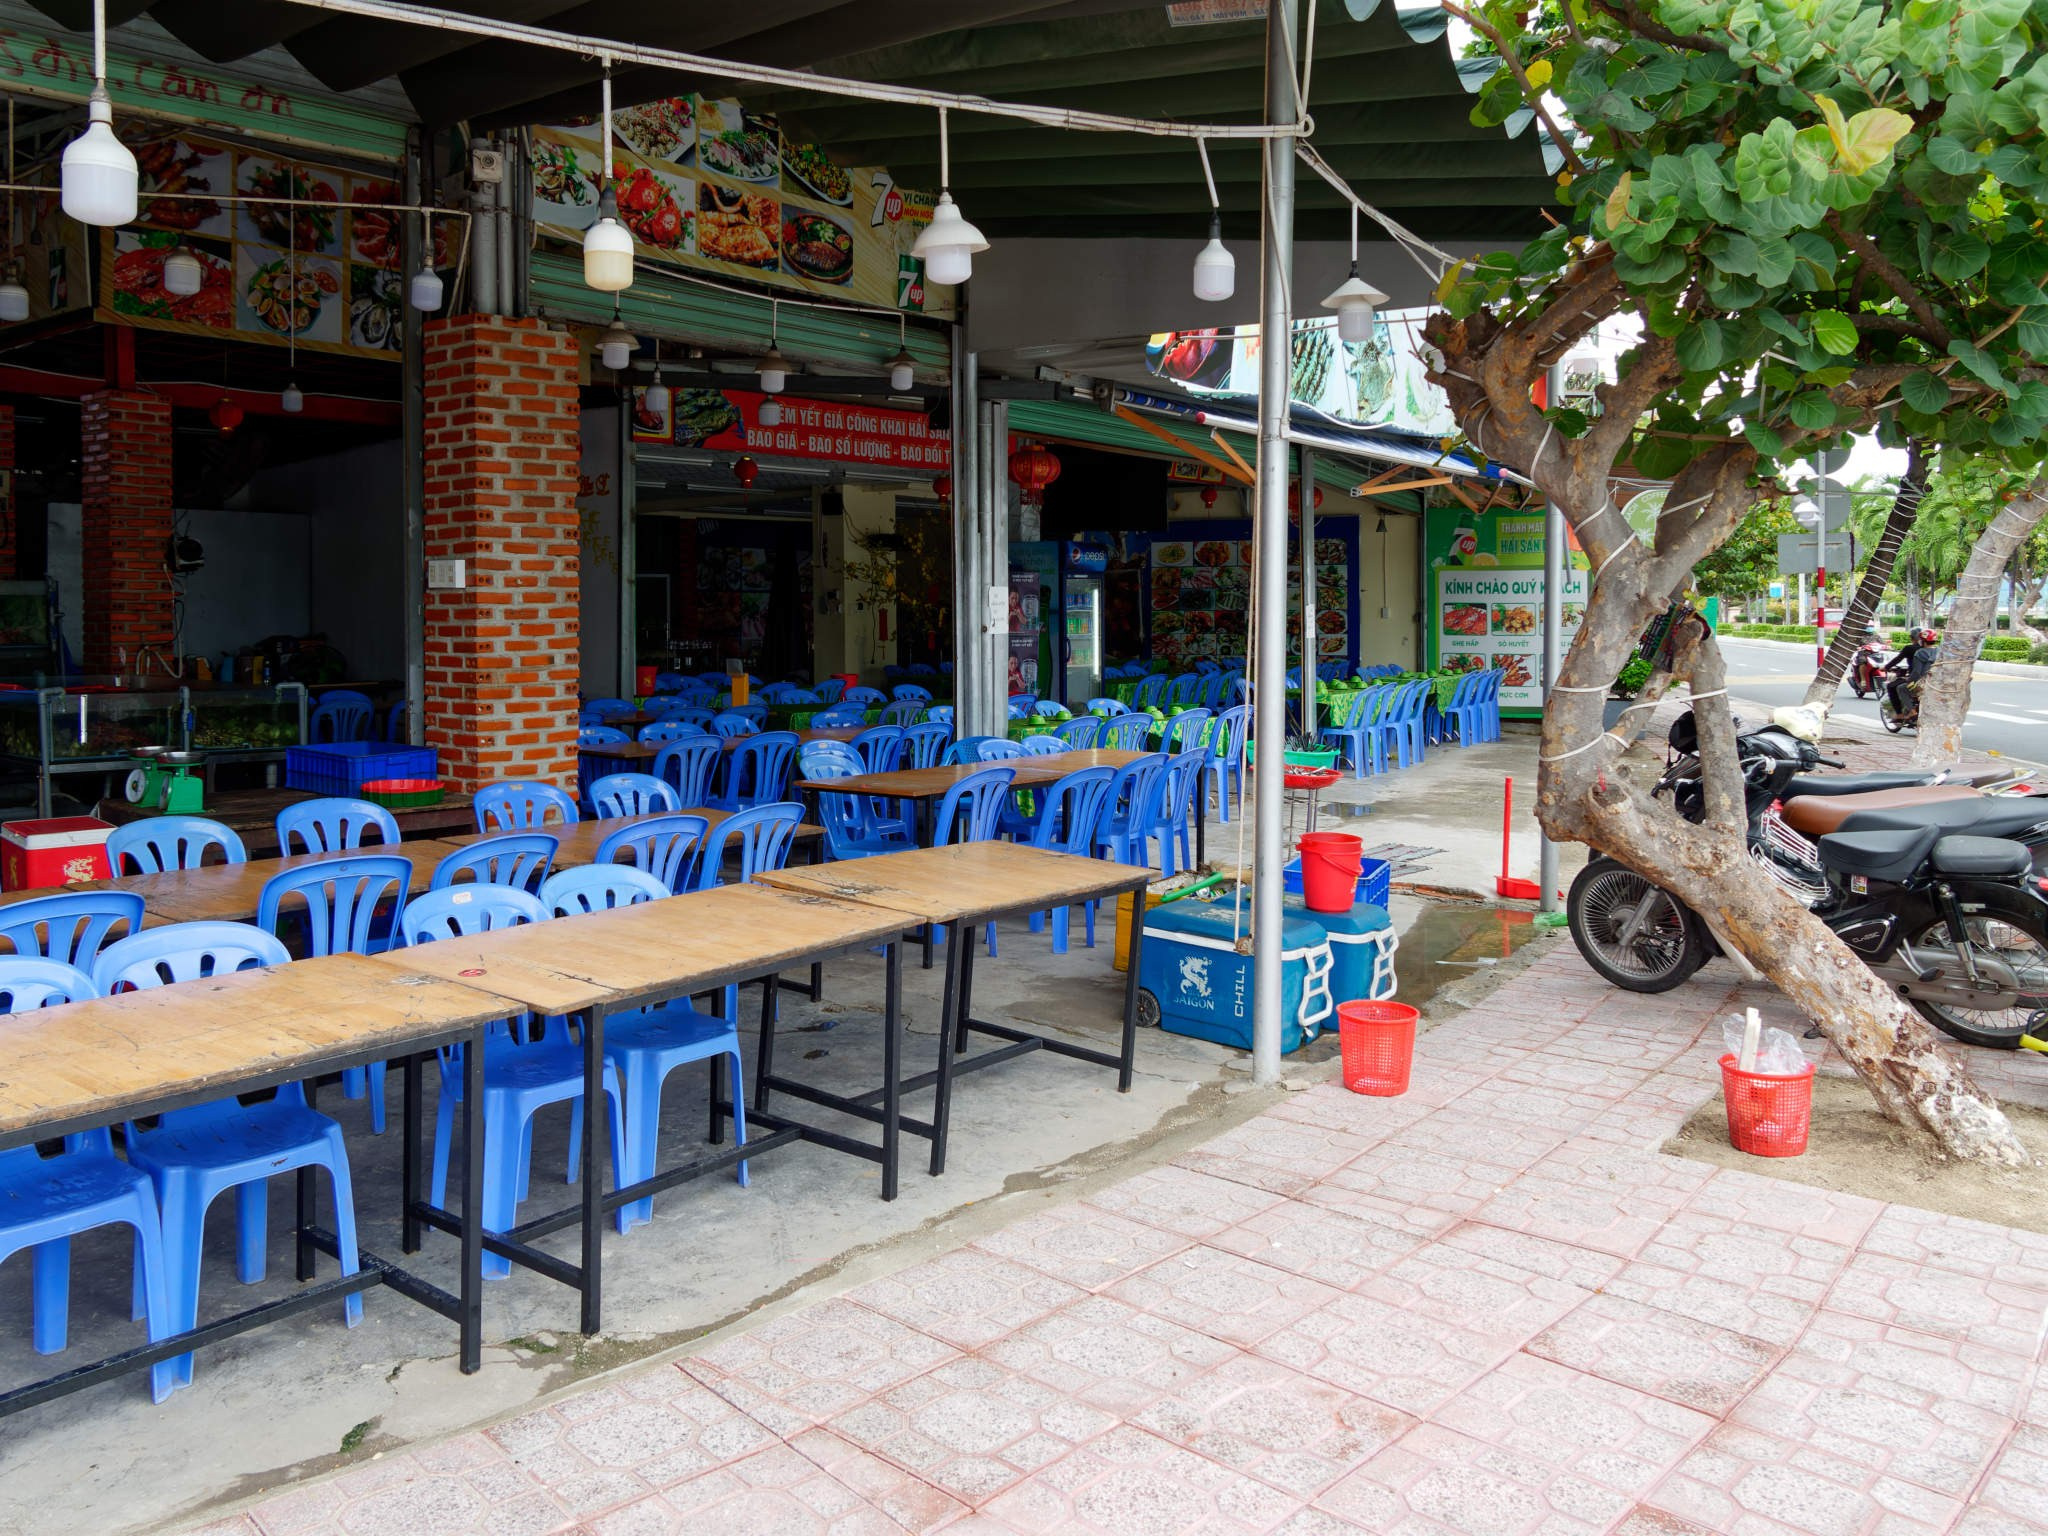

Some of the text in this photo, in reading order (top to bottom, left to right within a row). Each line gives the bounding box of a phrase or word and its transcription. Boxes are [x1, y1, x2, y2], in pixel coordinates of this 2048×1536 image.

[898, 270, 925, 308] 7up
[800, 400, 821, 428] YẾT
[824, 408, 844, 430] GIÁ
[847, 410, 877, 434] CÔNG
[880, 418, 906, 437] KHAI
[908, 418, 927, 439] HẢI
[747, 429, 773, 448] BAO
[776, 429, 797, 451] GIÁ
[808, 436, 832, 454] BAO
[835, 434, 851, 456] SỐ
[854, 439, 891, 462] LƯỢNG
[901, 446, 922, 462] BAO
[1520, 535, 1540, 554] SẢN
[1445, 578, 1581, 595] KÍNH CHÀO QUÝ KCH
[1234, 964, 1246, 1018] CHILL
